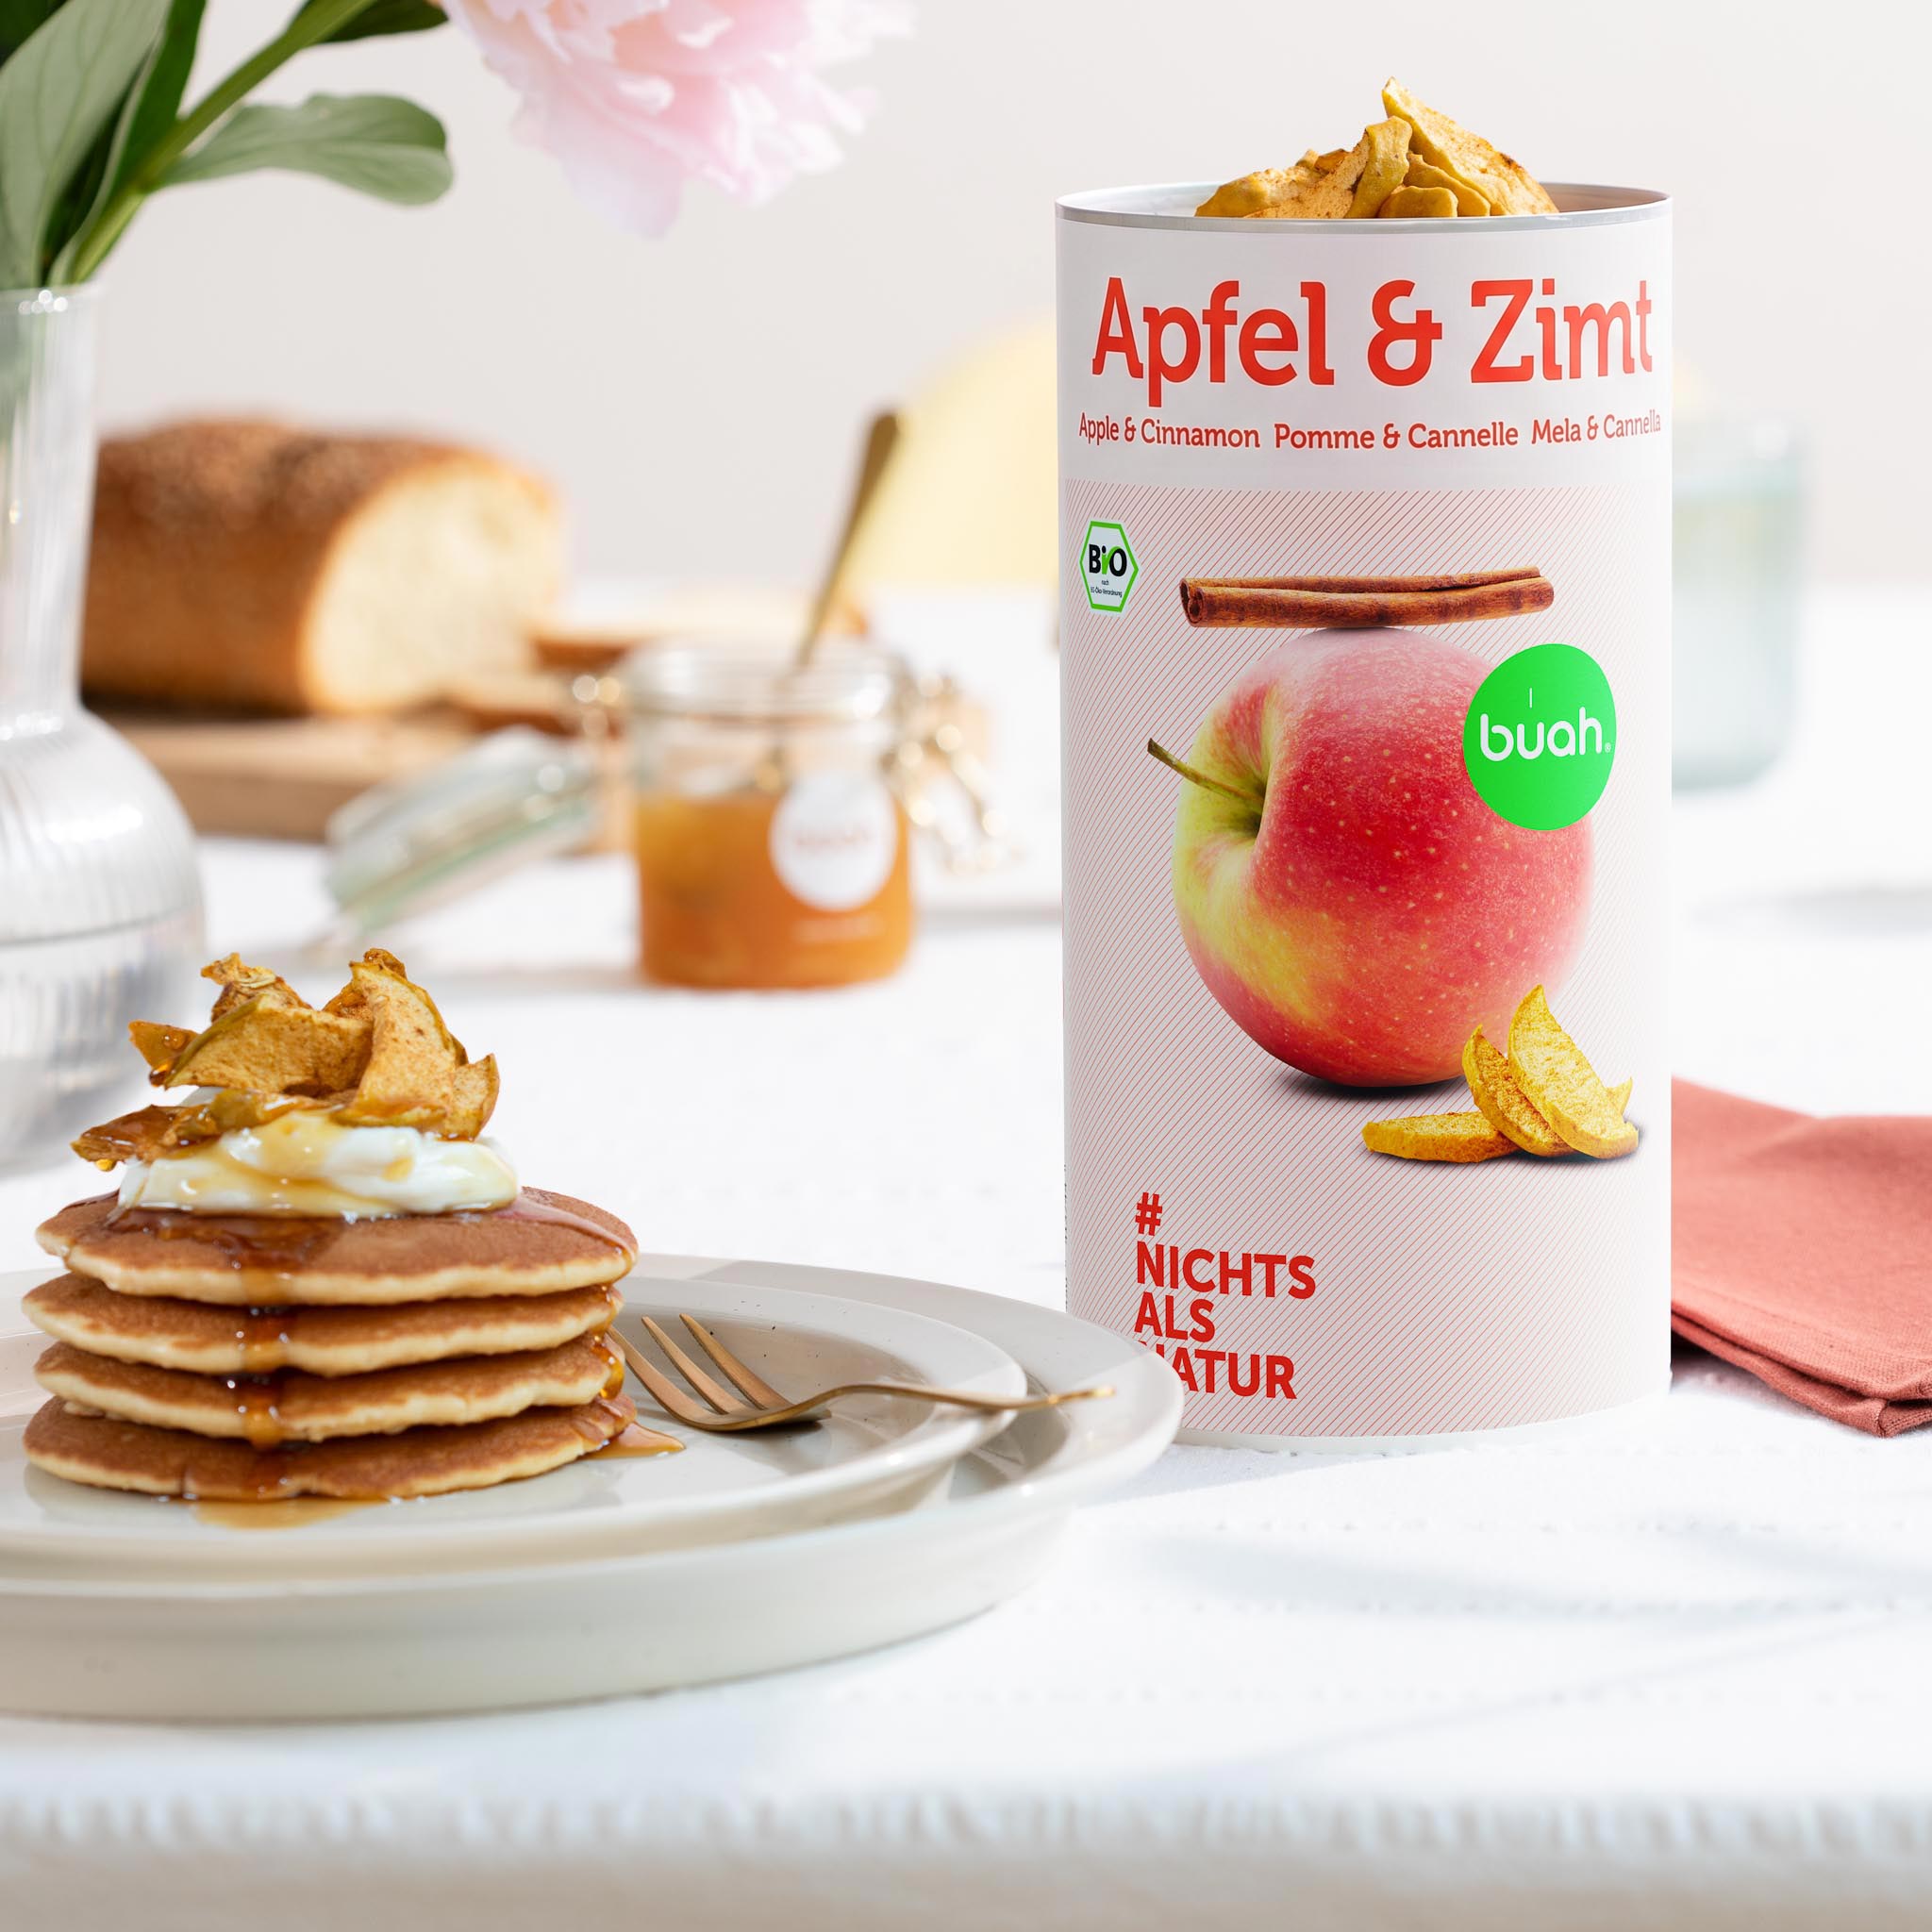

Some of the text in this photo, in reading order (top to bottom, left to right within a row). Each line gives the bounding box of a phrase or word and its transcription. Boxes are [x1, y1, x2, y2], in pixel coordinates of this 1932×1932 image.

[1091, 276, 1653, 408] Apfel & Zimt
[1079, 409, 1661, 450] Apple & Cinnamon Pomme & Cannelle Mela & Cannella
[1135, 1191, 1163, 1236] #
[1136, 1241, 1317, 1300] NICHTS
[1134, 1291, 1216, 1343] ALS
[1138, 1340, 1297, 1400] ATUR
